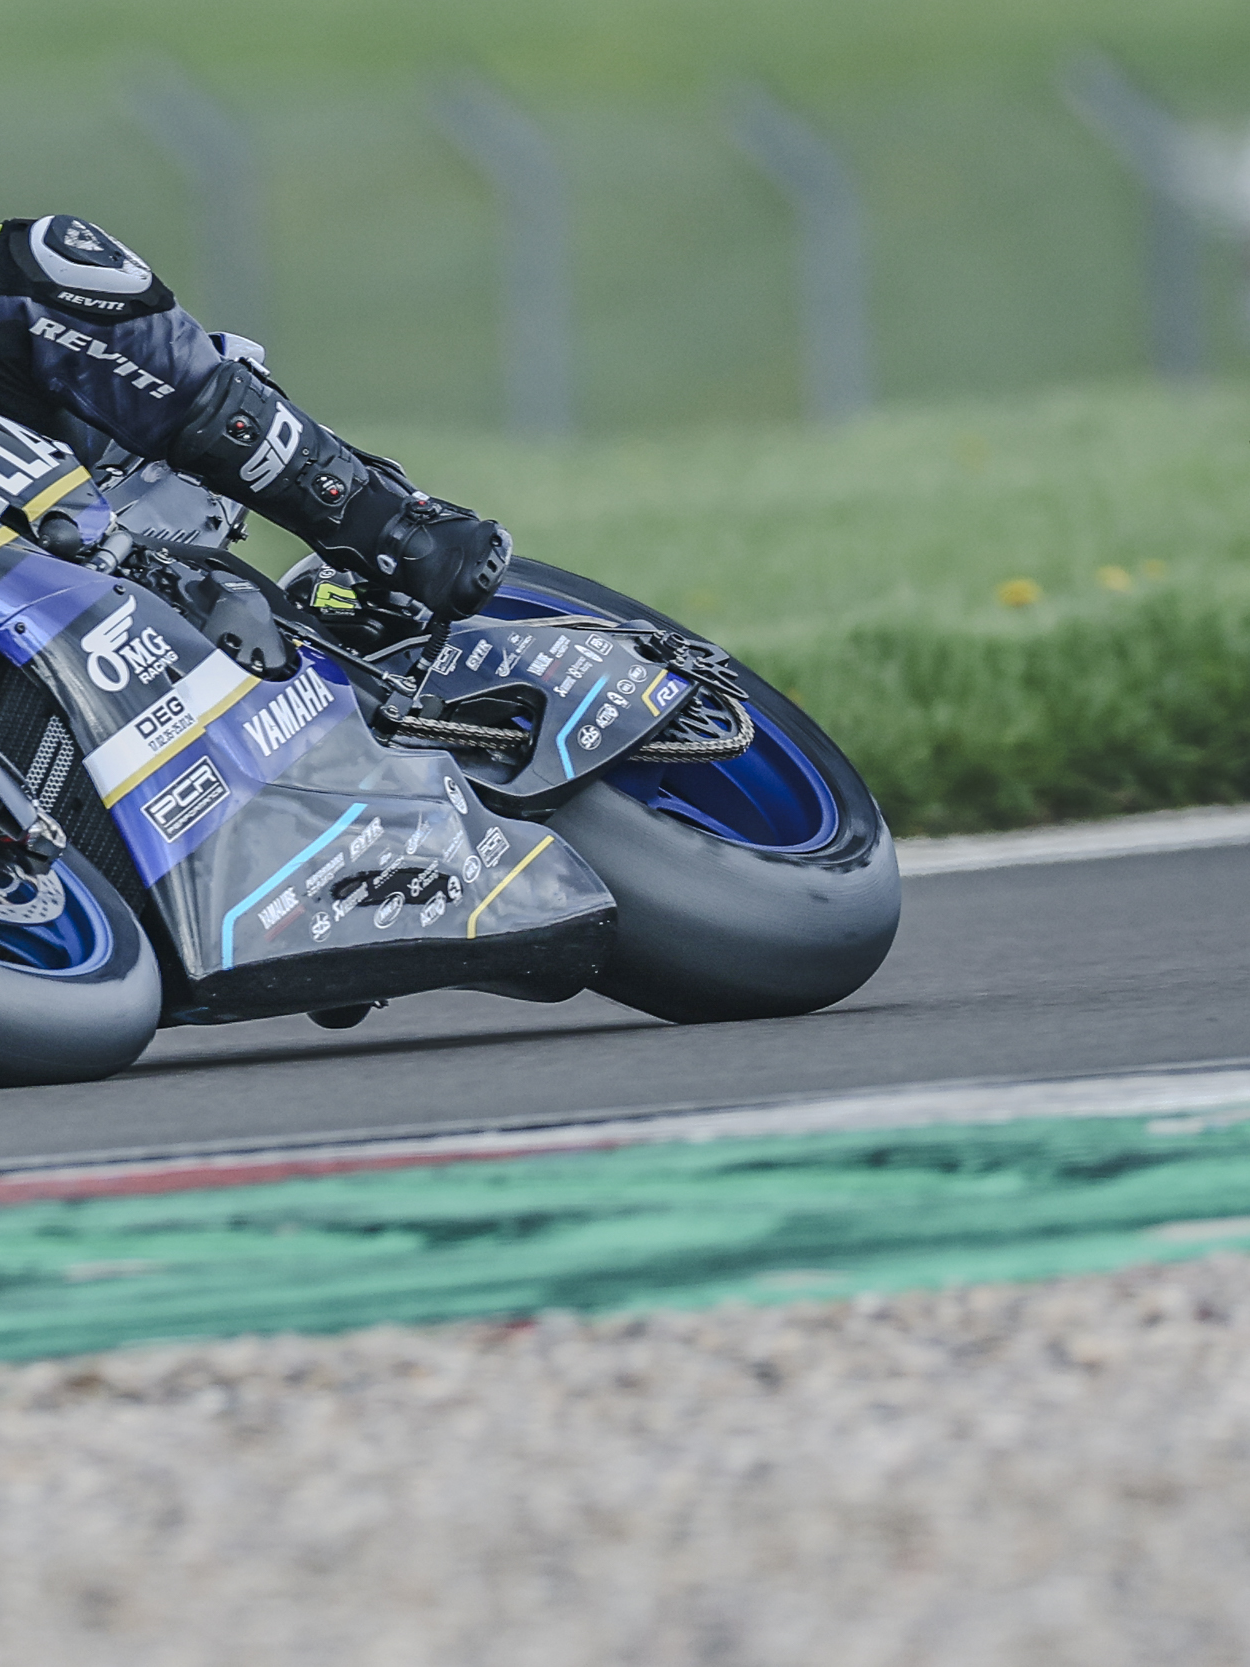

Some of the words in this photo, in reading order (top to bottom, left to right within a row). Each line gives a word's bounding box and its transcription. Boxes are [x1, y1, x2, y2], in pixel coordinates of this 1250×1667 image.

[138, 650, 179, 685] RACING
[135, 695, 185, 740] DEG
[243, 667, 335, 757] YAMAHA
[150, 764, 218, 824] PCR
